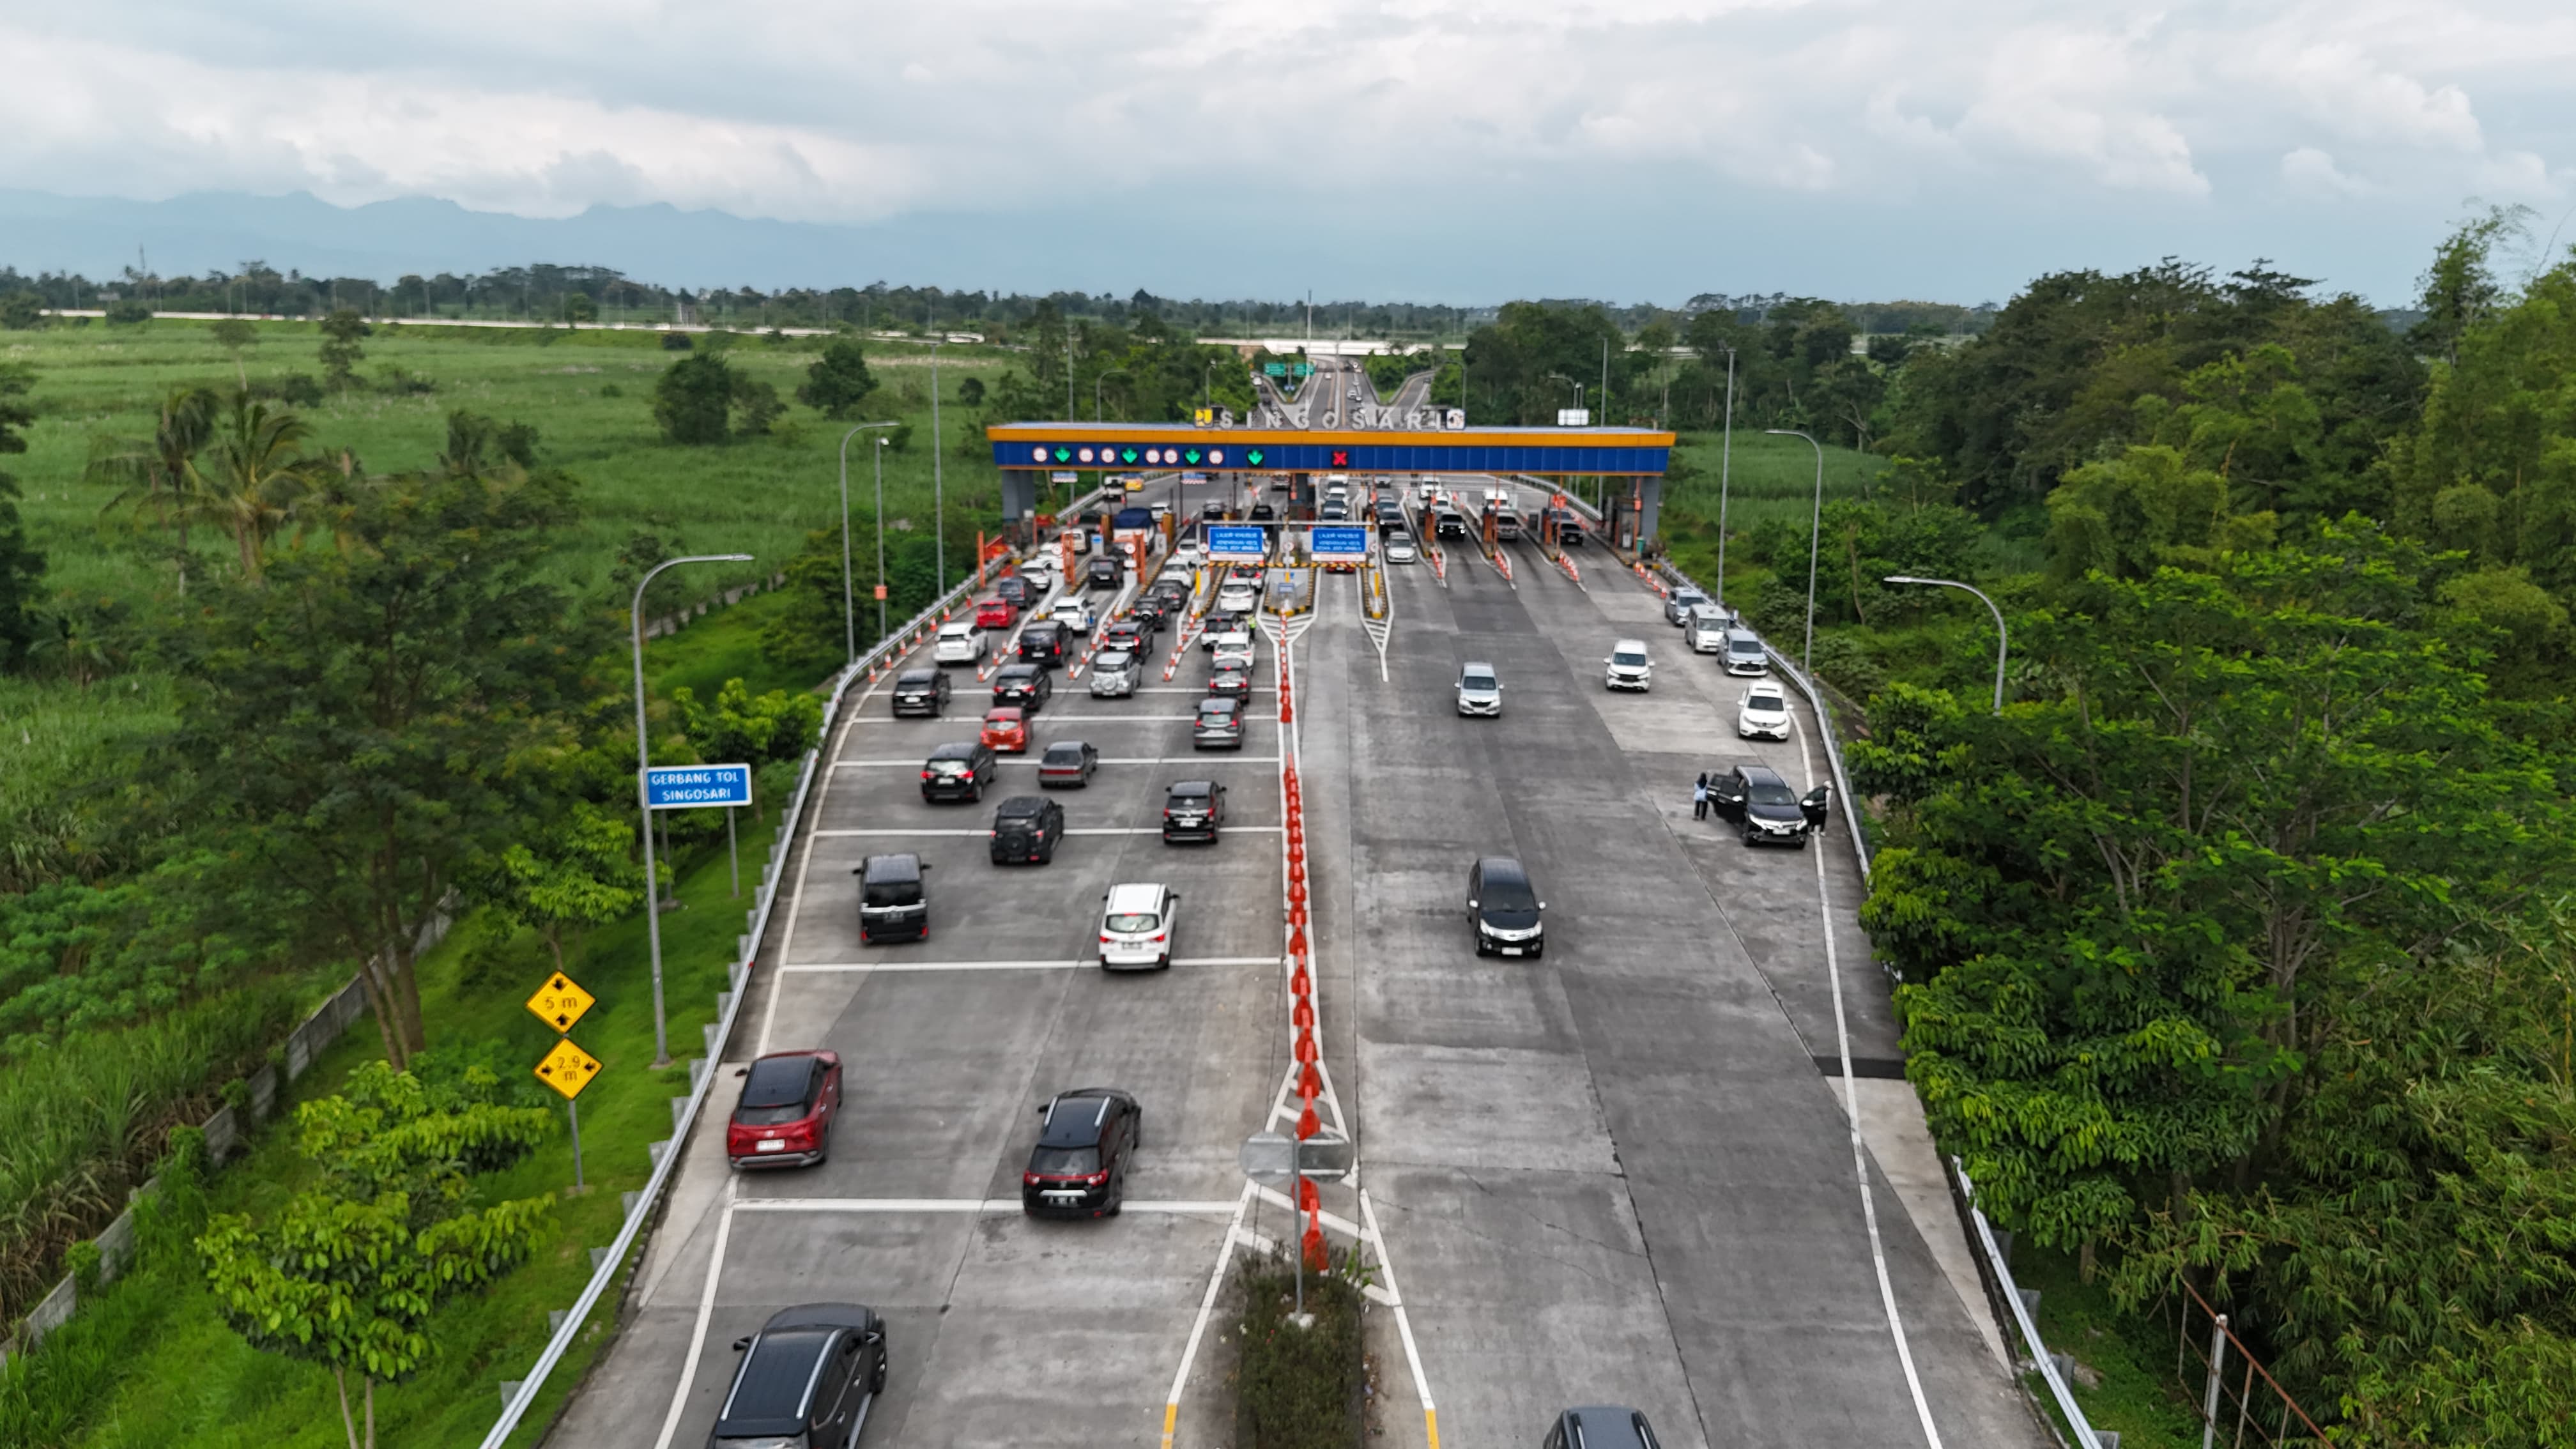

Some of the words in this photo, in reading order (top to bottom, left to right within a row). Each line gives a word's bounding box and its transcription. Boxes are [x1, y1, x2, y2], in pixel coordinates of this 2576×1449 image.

[651, 772, 711, 785] GERBANG
[716, 771, 739, 783] TOL
[663, 788, 731, 801] SINGOSARI
[545, 997, 555, 1009] 5
[562, 997, 578, 1009] m
[556, 1055, 581, 1070] 2.9
[564, 1071, 578, 1082] m
